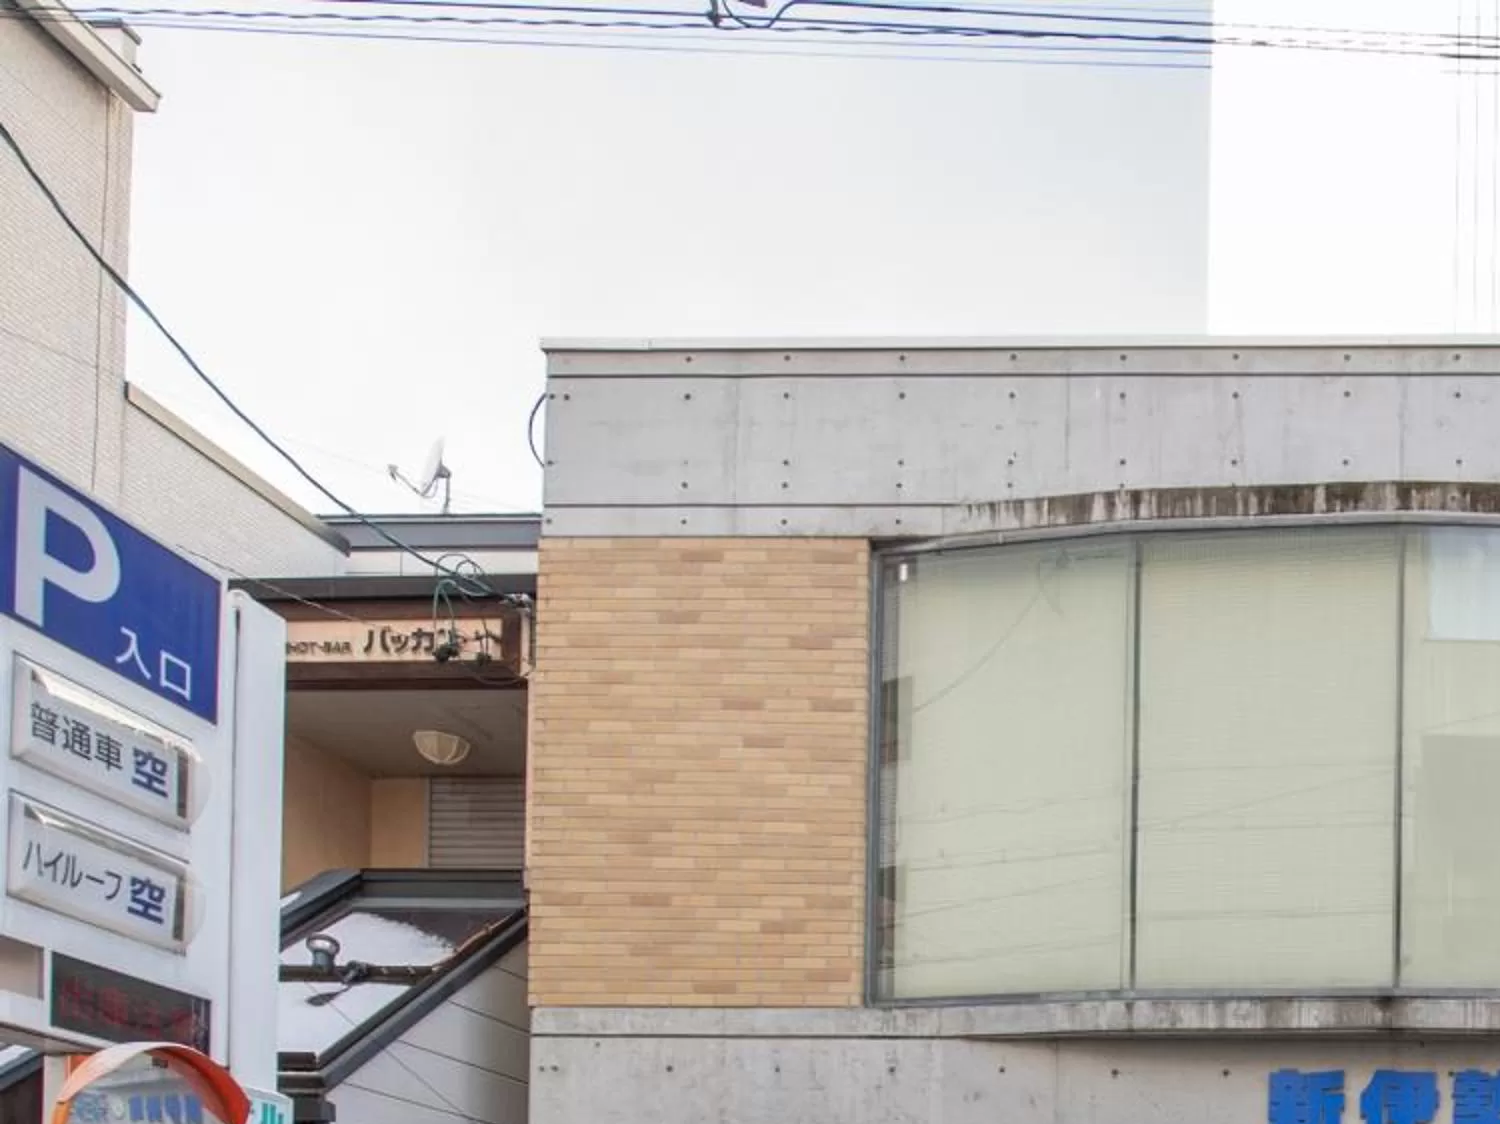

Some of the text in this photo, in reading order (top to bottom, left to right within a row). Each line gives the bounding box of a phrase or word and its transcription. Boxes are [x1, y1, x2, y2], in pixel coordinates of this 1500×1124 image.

[14, 465, 121, 628] P
[115, 626, 191, 700] 入口
[31, 701, 169, 798] 普通車 空
[22, 841, 165, 924] ハイルーフ 空
